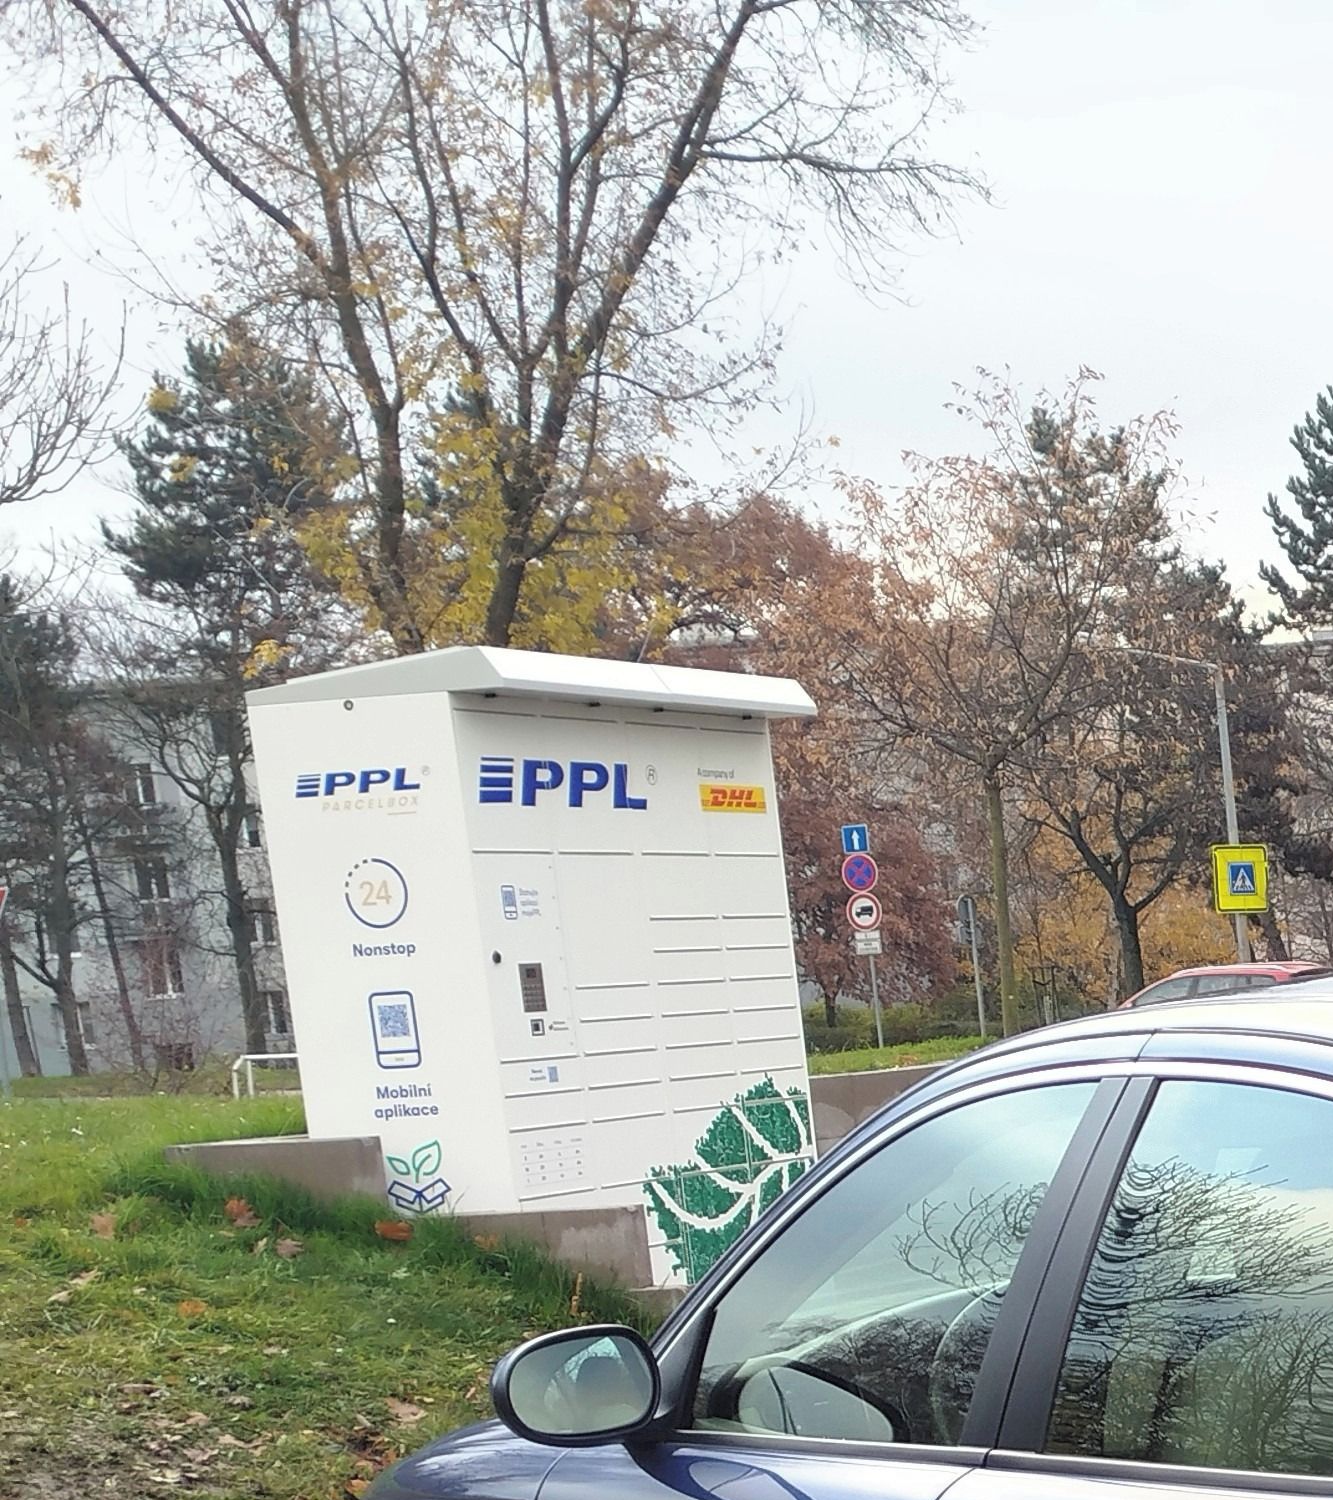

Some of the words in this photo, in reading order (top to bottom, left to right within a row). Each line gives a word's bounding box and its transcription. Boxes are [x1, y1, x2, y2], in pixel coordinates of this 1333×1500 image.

[324, 767, 420, 796] PPL
[521, 758, 648, 811] PPL
[322, 796, 419, 812] PARCELBOX
[710, 788, 757, 808] DHL
[359, 880, 392, 906] 24
[352, 943, 416, 957] Nonstop
[376, 1083, 432, 1100] Mobilní
[374, 1104, 439, 1121] aplikace
